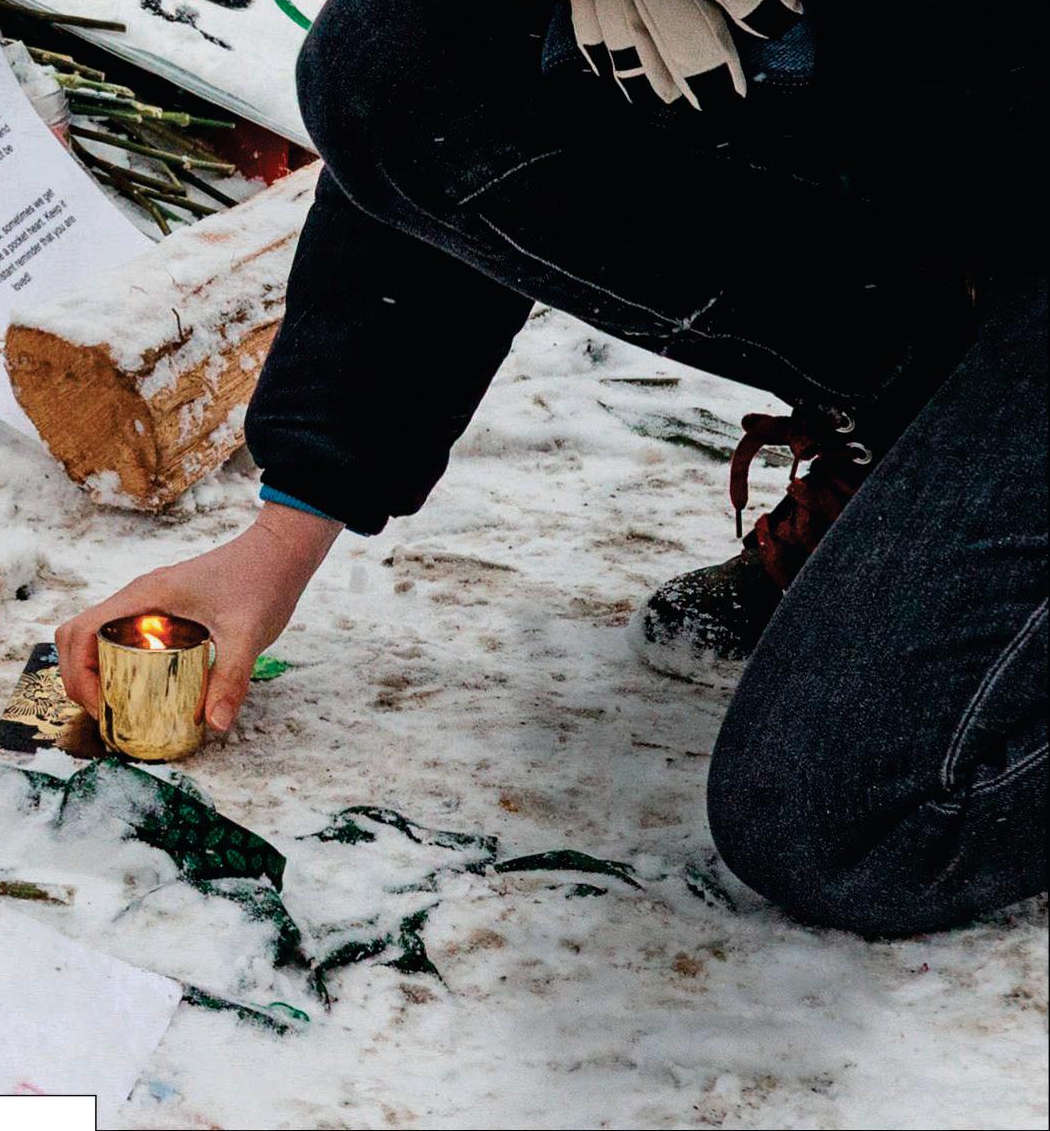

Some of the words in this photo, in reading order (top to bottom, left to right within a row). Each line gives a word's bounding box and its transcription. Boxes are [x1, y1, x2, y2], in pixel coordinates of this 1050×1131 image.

[1, 205, 35, 234] sometimes
[7, 230, 29, 253] pocket
[43, 204, 62, 221] Keep
[14, 242, 42, 267] reminder
[38, 232, 55, 246] that
